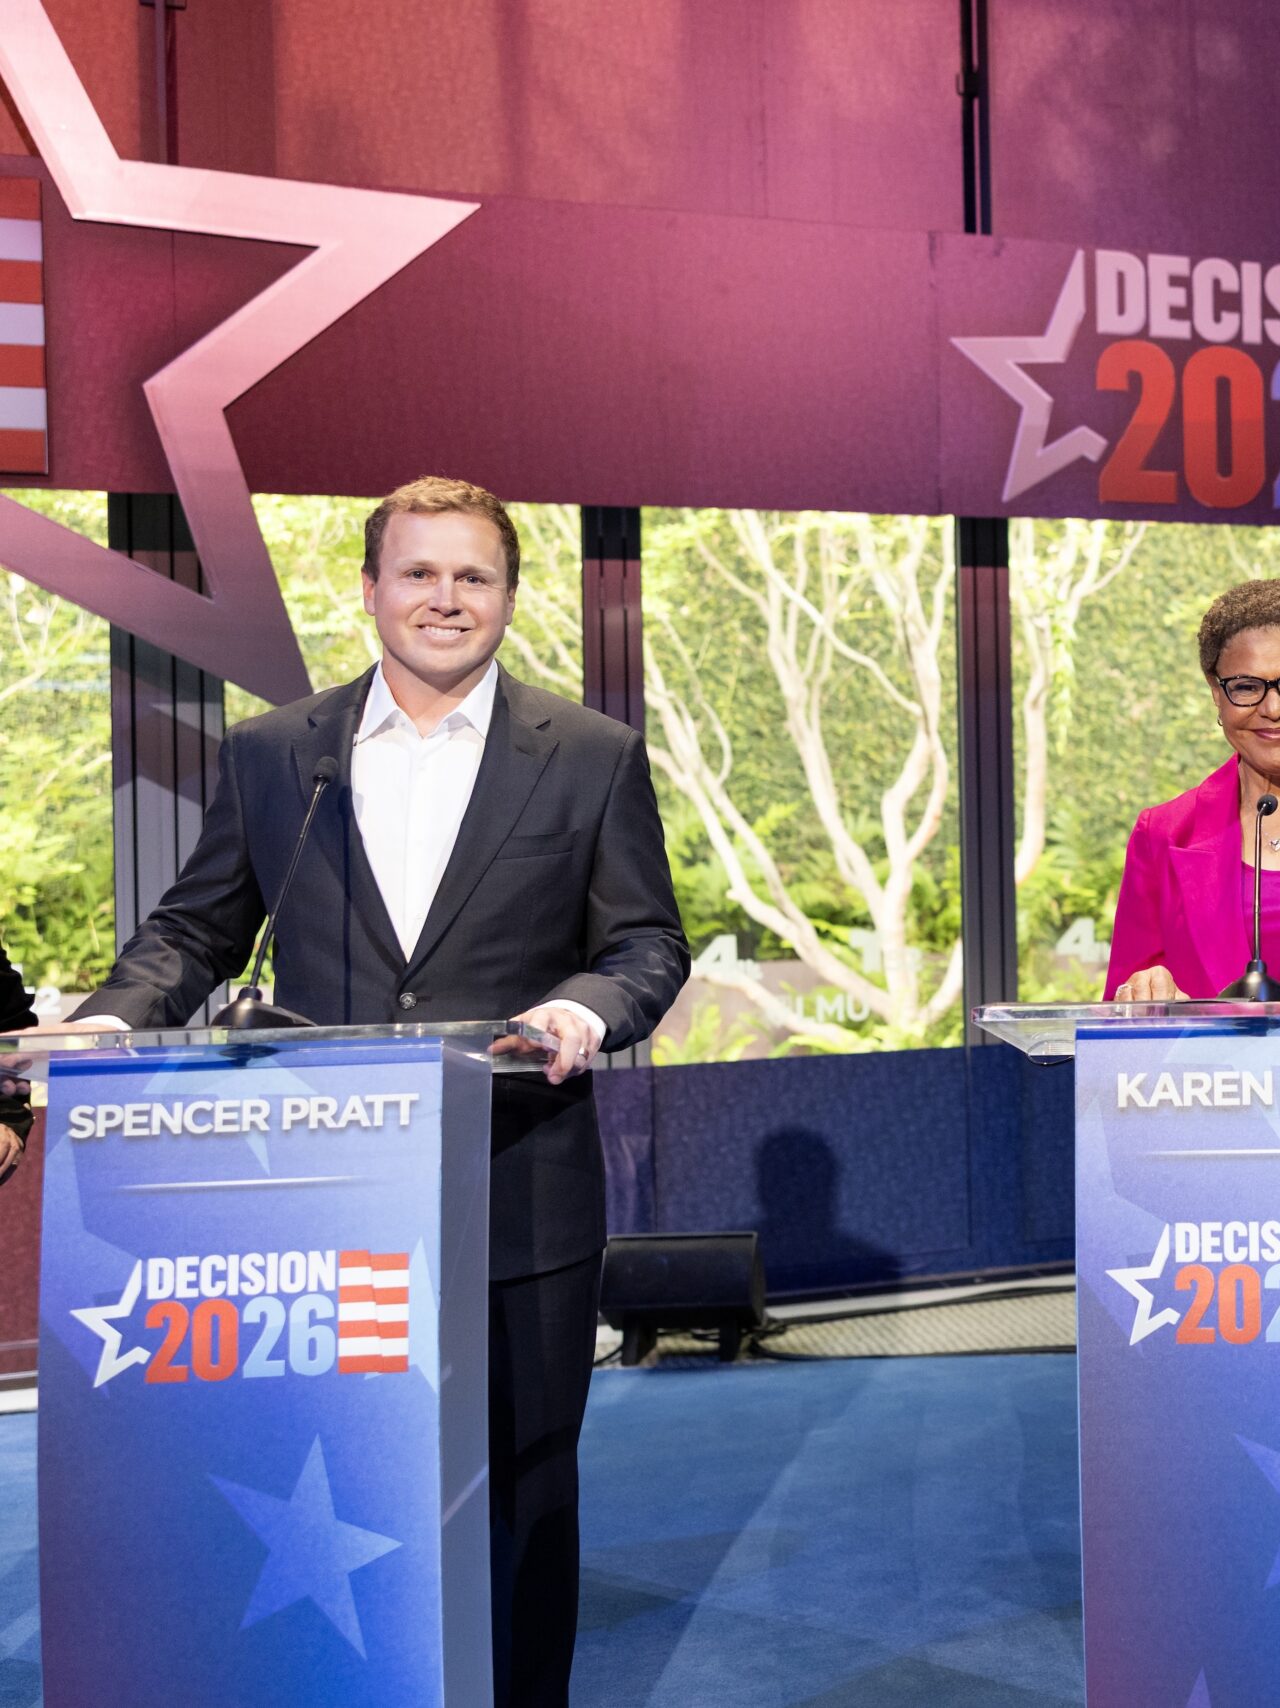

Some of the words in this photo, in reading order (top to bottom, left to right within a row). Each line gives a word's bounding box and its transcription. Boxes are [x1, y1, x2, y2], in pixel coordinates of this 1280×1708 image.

[1117, 1071, 1273, 1108] KAREN
[68, 1099, 270, 1139] SPENCER
[283, 1093, 419, 1131] PRATT
[147, 1250, 336, 1299] DECISION
[145, 1294, 335, 1384] 2026
